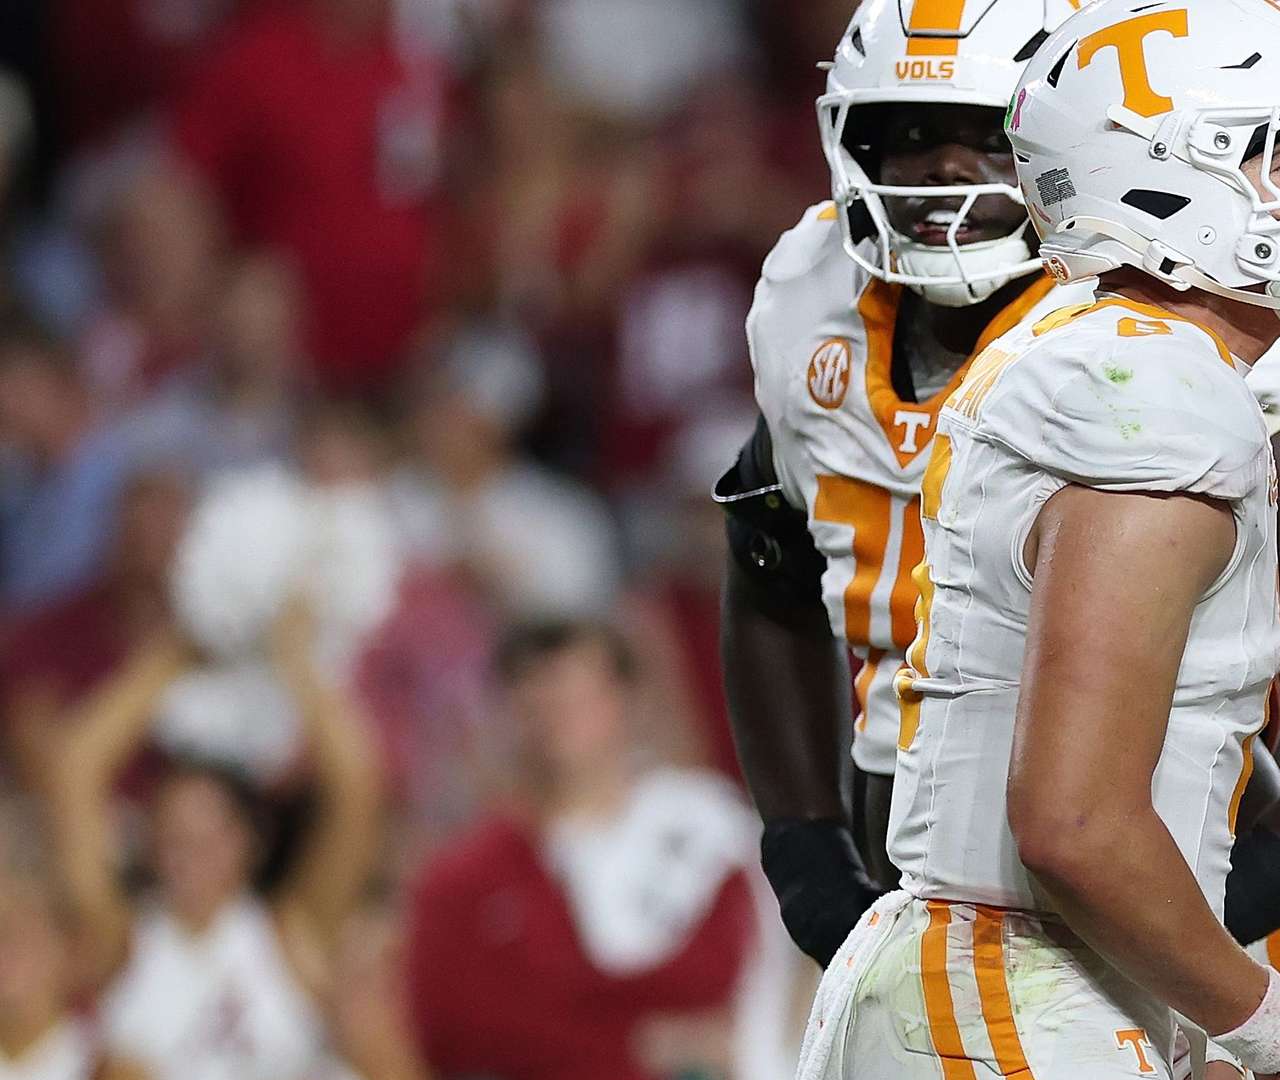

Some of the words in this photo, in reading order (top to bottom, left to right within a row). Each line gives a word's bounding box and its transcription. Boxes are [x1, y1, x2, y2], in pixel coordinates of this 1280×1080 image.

[895, 60, 956, 80] VOLS
[1078, 8, 1189, 118] T
[809, 342, 849, 402] SEC
[893, 410, 931, 454] T
[1115, 1028, 1154, 1073] T
